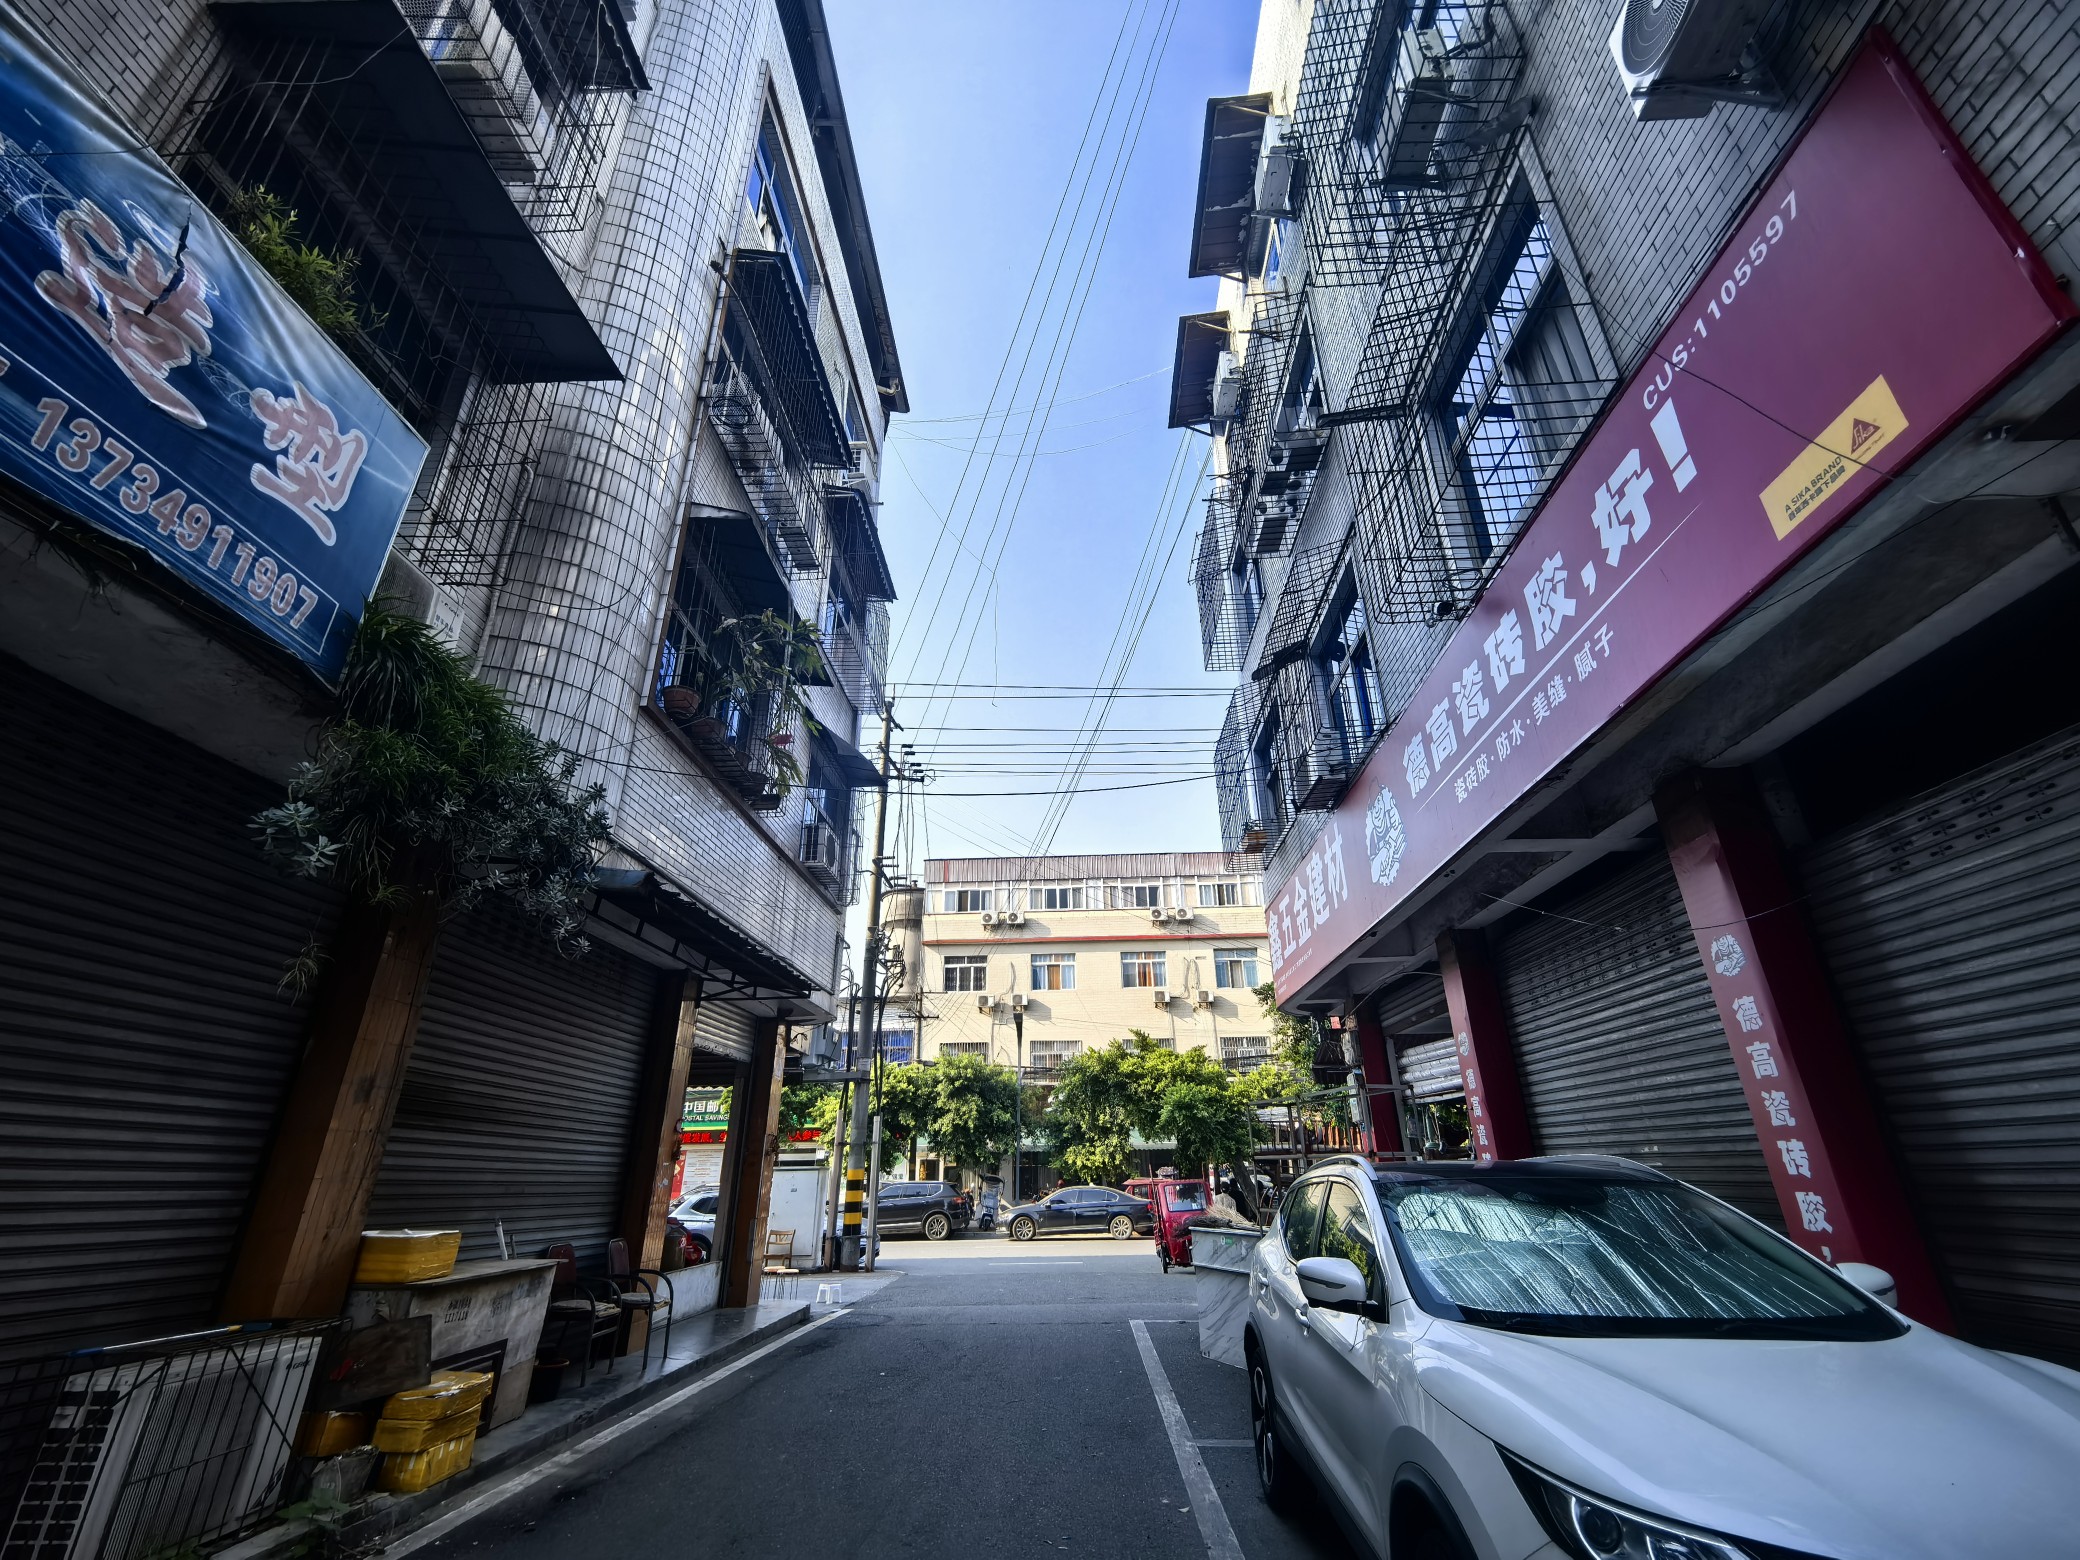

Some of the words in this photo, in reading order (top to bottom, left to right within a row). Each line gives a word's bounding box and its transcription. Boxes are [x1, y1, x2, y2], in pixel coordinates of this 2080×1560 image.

[1642, 190, 1798, 411] CUS:1105597
[1853, 424, 1875, 449] Sika
[30, 396, 319, 630] 13734911907
[1785, 504, 1791, 513] A
[1791, 484, 1811, 506] SIKA
[1810, 456, 1842, 489] BRAND
[683, 1100, 724, 1113] 中国邮
